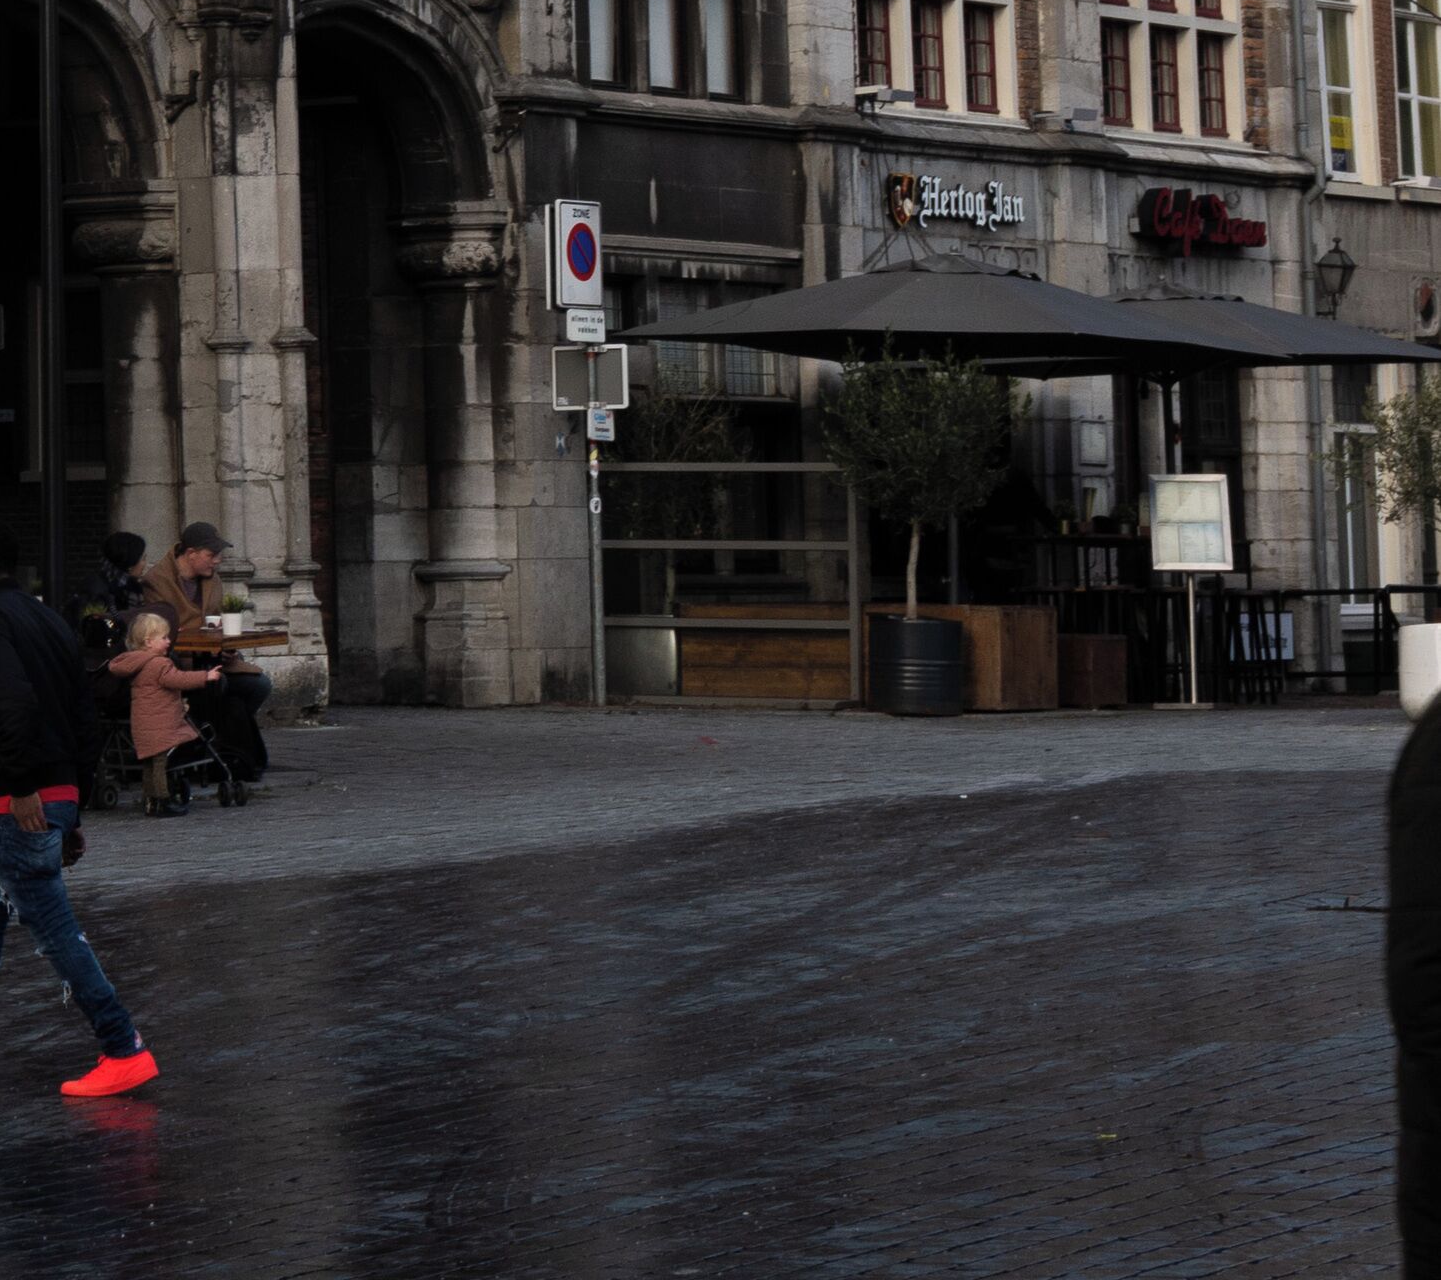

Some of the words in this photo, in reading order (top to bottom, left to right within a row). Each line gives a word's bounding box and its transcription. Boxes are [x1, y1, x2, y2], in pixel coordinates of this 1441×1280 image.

[572, 208, 590, 219] ZONE
[919, 175, 987, 229] Hertog
[988, 181, 1026, 233] Jan
